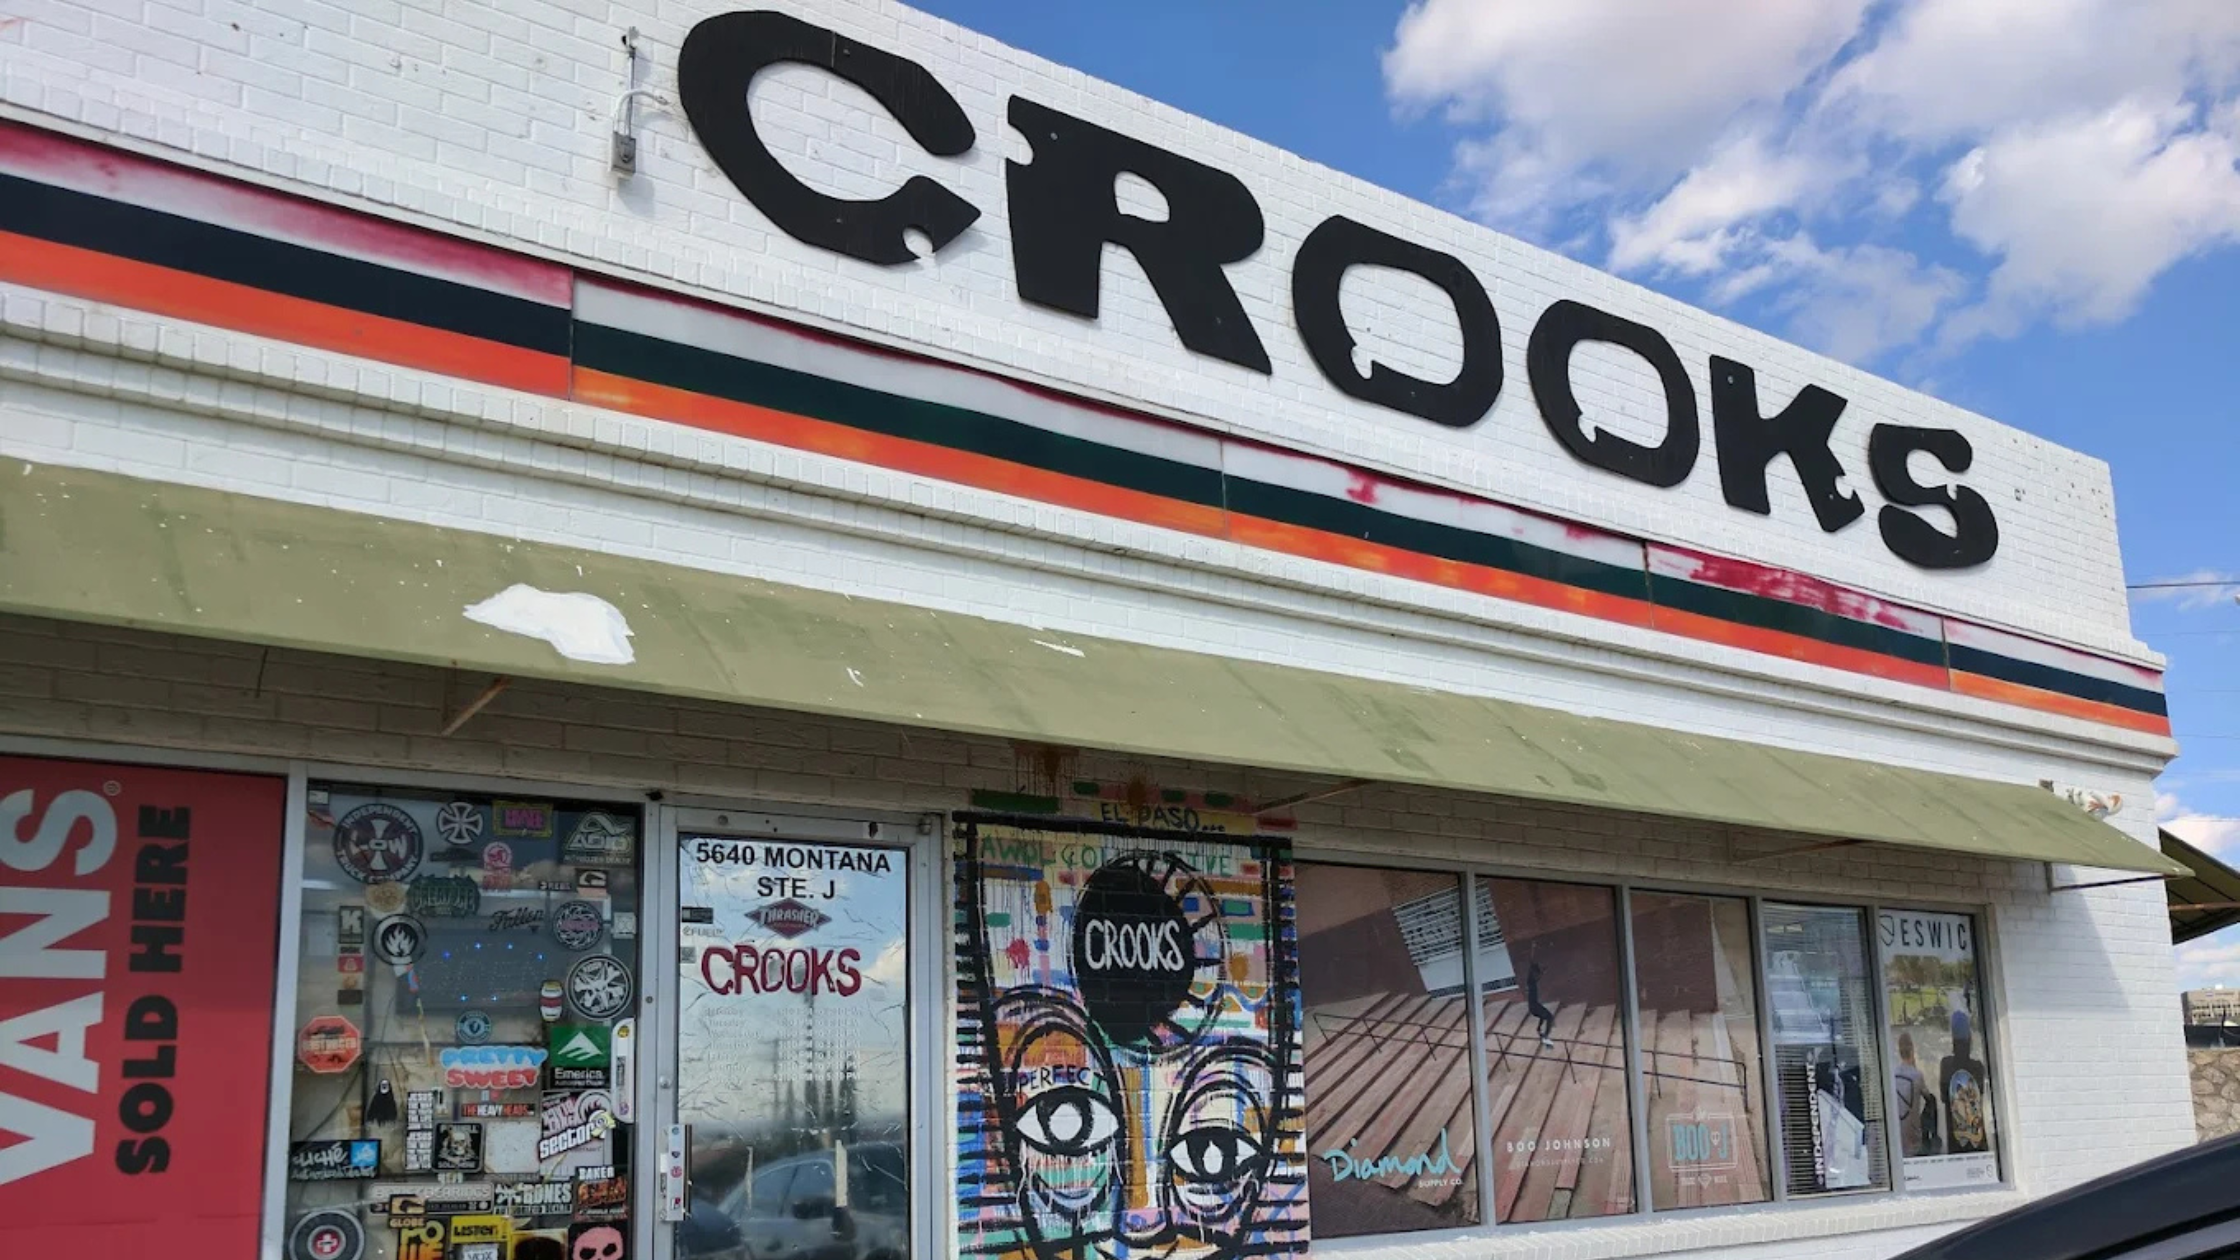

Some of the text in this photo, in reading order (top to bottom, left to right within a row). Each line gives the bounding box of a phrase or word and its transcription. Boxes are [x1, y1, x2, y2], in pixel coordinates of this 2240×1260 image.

[678, 9, 1999, 571] CROOKS
[341, 804, 418, 834] INDEPENDENT
[1101, 803, 1128, 823] EL
[337, 849, 367, 882] TRUCK
[696, 842, 892, 873] 5640 MONTANA
[757, 876, 836, 899] STE. J
[489, 906, 545, 933] Fallen
[759, 907, 821, 929] THRASHER
[1084, 918, 1186, 972] CROOKS
[1901, 918, 1968, 951] ESWIC
[701, 943, 862, 997] CROOKS
[0, 788, 118, 1185] VANS
[116, 804, 192, 1176] SOLD HERE
[440, 1046, 548, 1068] PRETTY
[446, 1069, 539, 1089] SWEET
[408, 1092, 433, 1101] JESUS
[1806, 1062, 1825, 1176] INDEPENDENT
[540, 1120, 608, 1159] sector
[1323, 1127, 1461, 1182] Diamond
[1506, 1137, 1611, 1153] BOO JOHNSON
[1673, 1122, 1711, 1161] BOO
[578, 1166, 615, 1181] BAKER
[1419, 1179, 1448, 1188] SUPPLY
[523, 1182, 573, 1205] BONES
[389, 1217, 426, 1228] GLOBE
